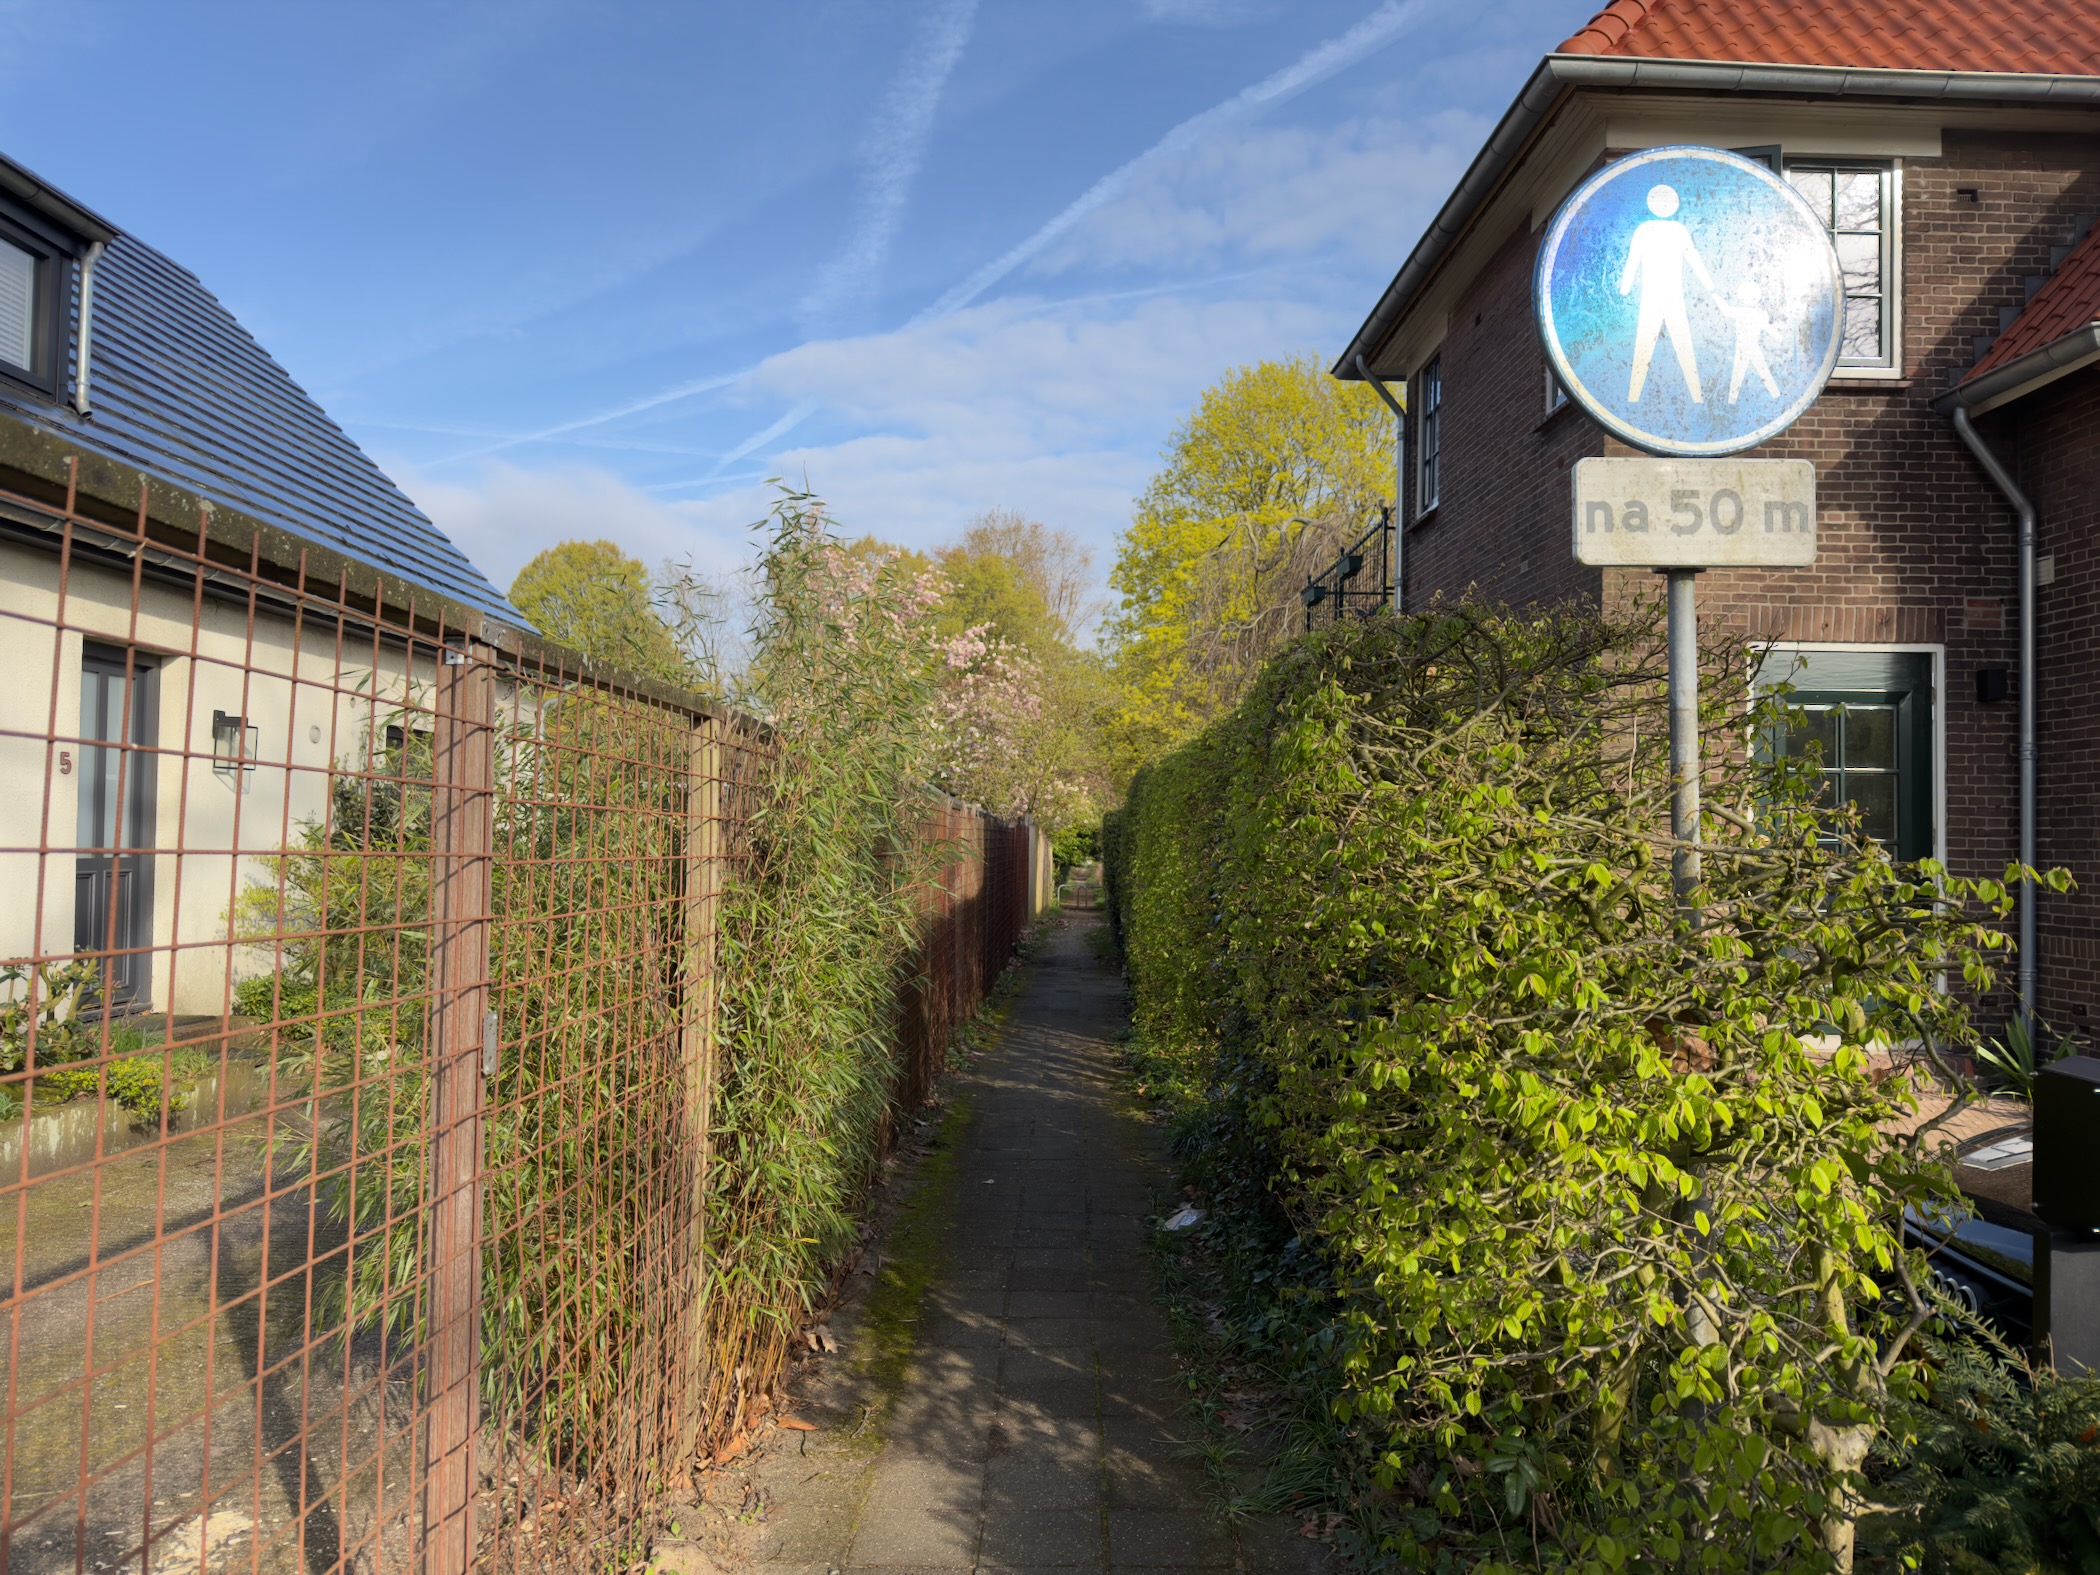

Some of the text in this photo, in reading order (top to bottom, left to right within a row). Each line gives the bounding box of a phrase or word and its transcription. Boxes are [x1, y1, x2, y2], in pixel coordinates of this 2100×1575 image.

[1585, 488, 1809, 536] na 50 m
[60, 751, 72, 775] 5
